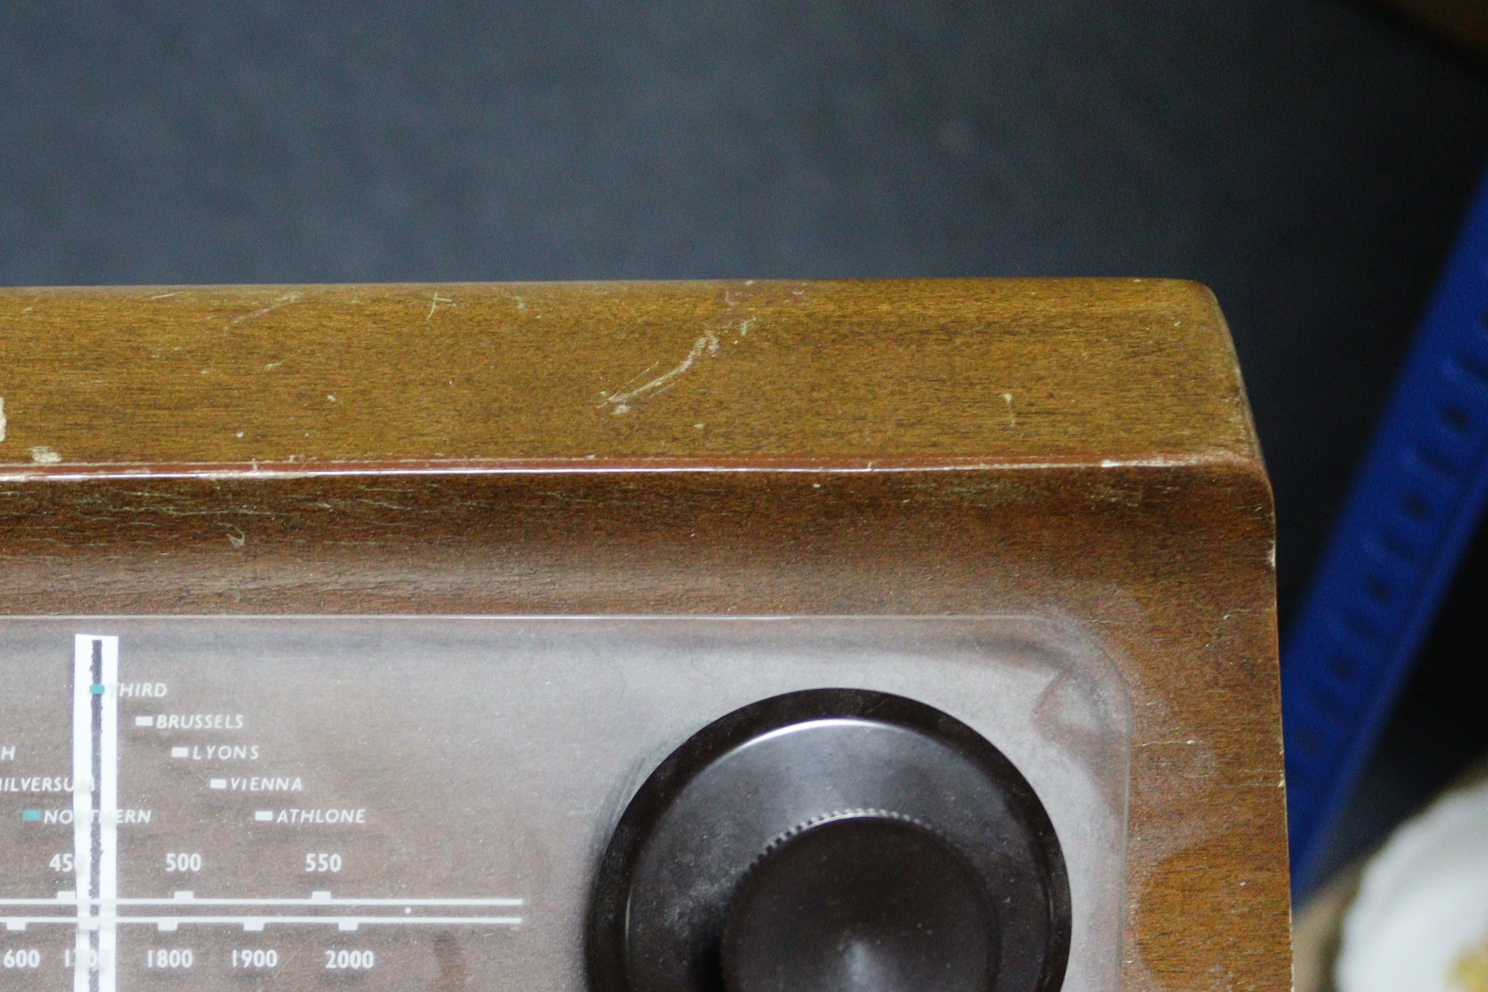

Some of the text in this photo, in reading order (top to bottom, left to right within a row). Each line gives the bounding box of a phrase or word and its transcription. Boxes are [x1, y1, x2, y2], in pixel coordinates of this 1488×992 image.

[156, 714, 244, 729] BRUSSELS
[192, 744, 259, 761] LYONS
[230, 776, 303, 792] VIENNA
[43, 809, 152, 825] NOTERN
[276, 808, 366, 824] ATHLONE
[165, 852, 202, 872] 500
[305, 852, 342, 873] 550
[65, 948, 111, 969] 100
[147, 948, 194, 969] 1800
[231, 948, 278, 968] 1900
[325, 949, 375, 970] 2000
